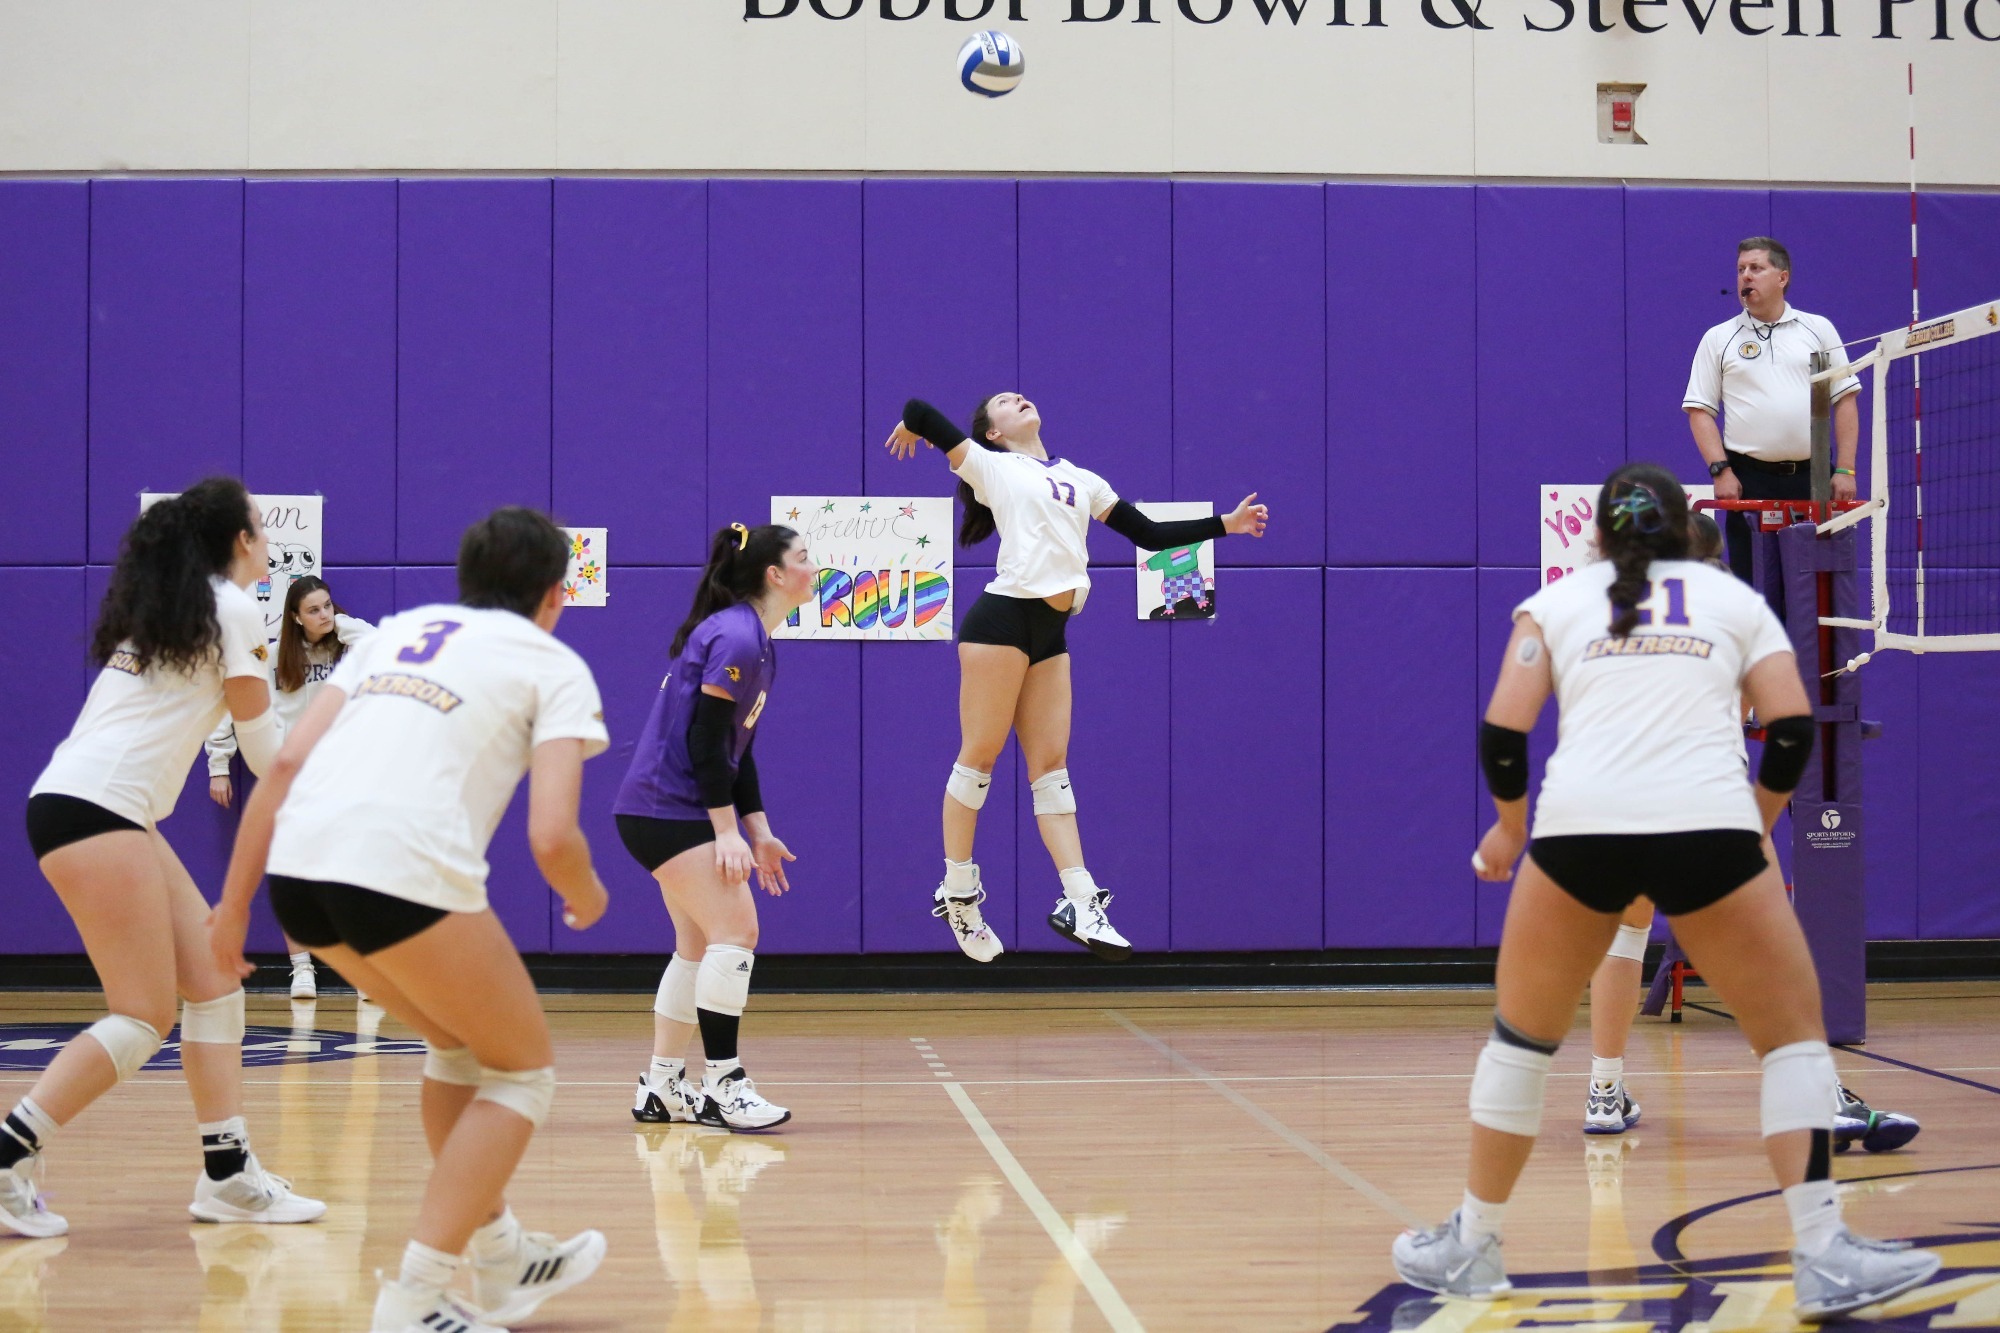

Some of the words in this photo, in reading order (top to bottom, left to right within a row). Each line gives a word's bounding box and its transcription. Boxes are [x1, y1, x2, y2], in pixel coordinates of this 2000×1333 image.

[786, 567, 950, 631] ROUD
[396, 620, 463, 665] 3
[1582, 634, 1714, 662] EMERSON
